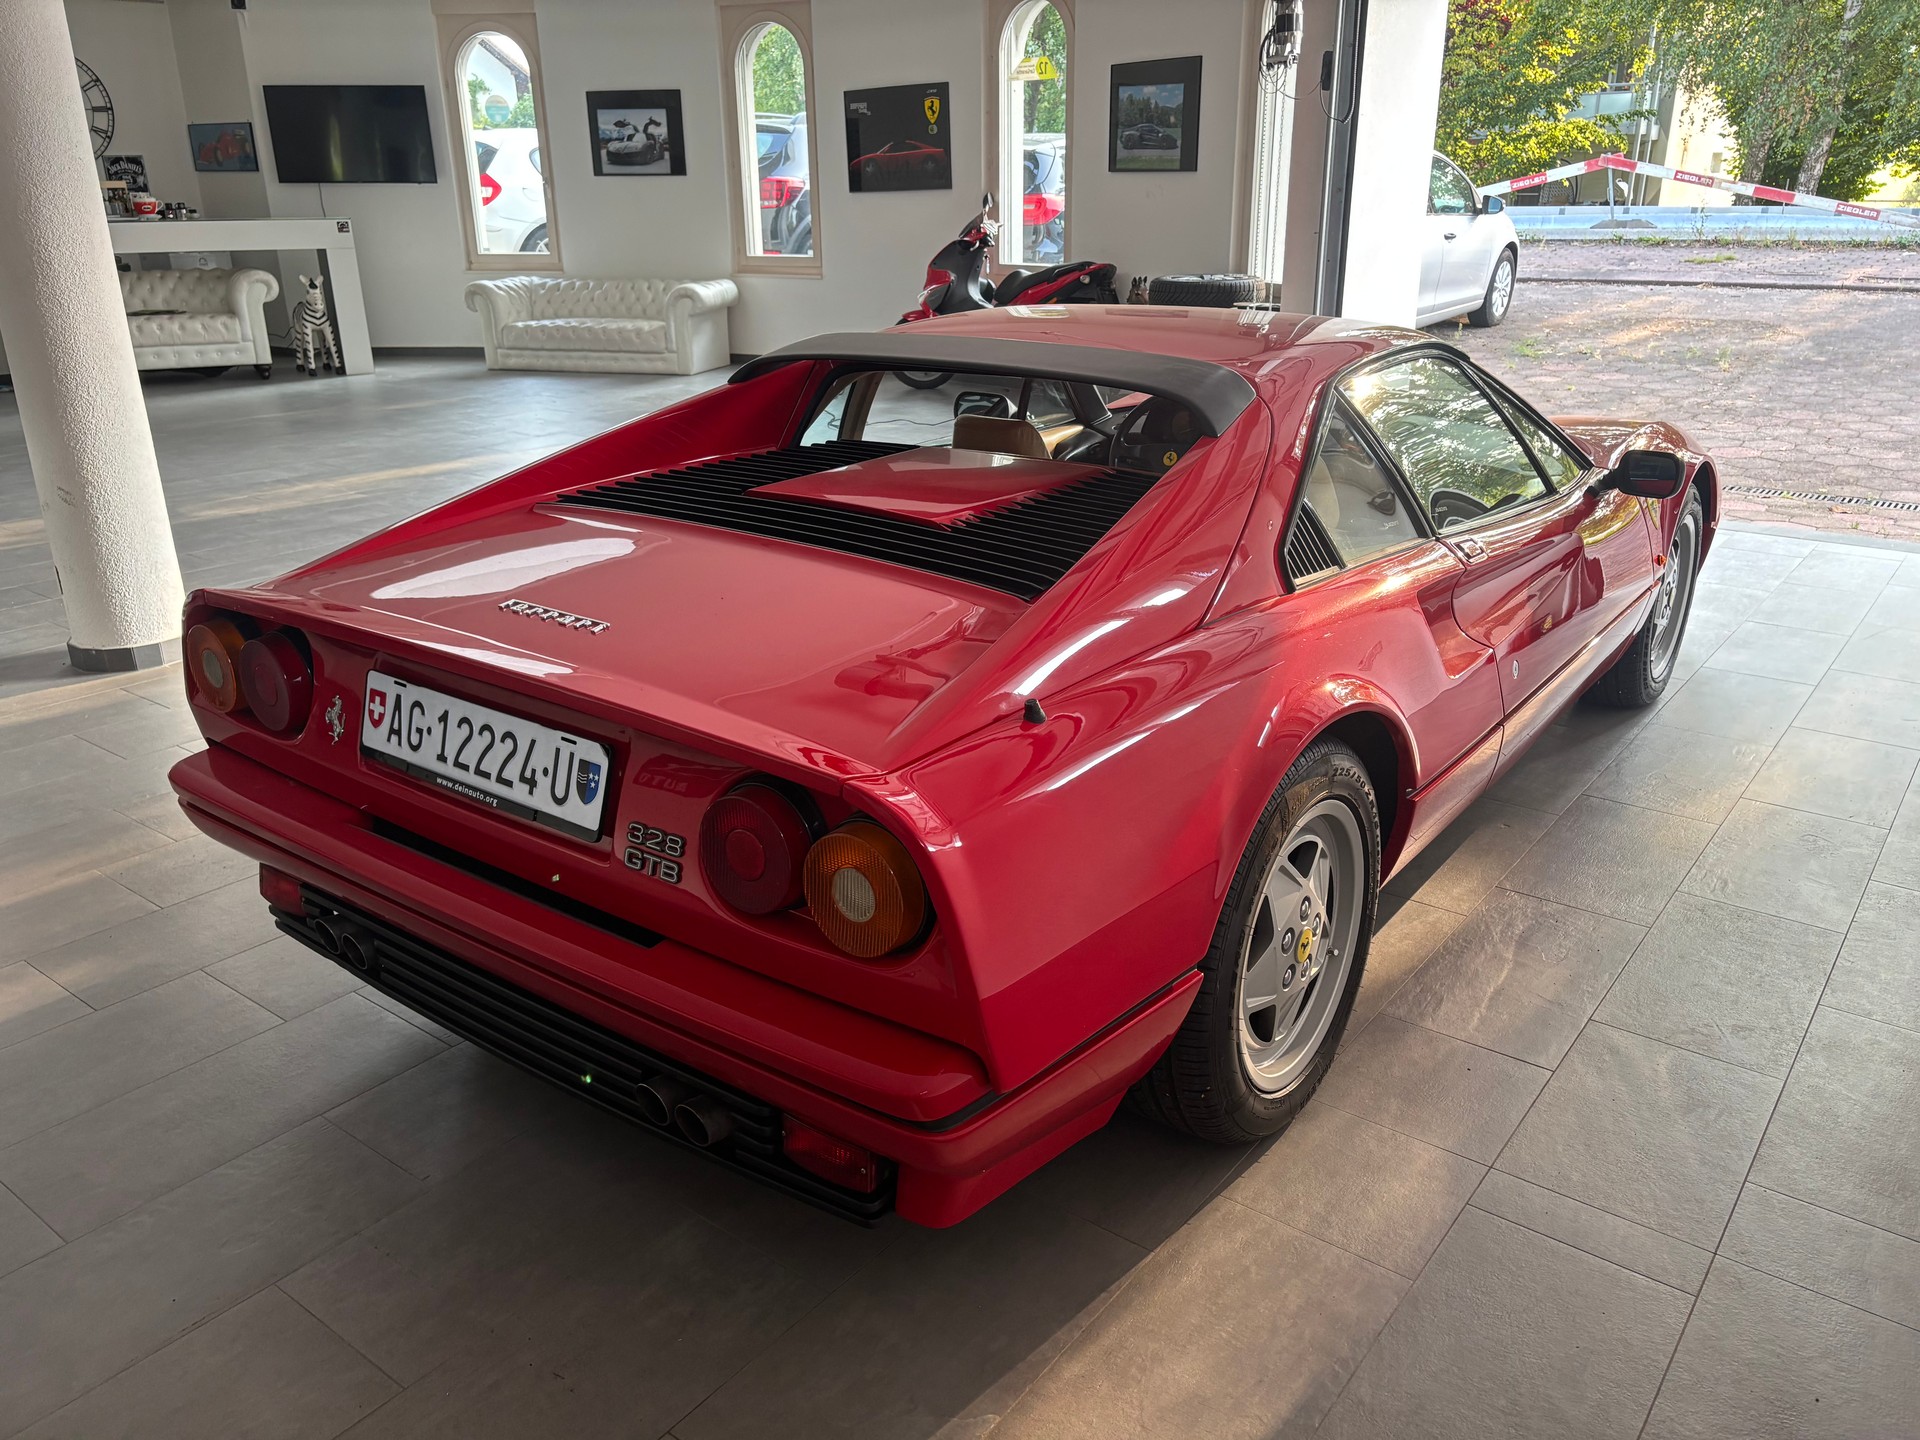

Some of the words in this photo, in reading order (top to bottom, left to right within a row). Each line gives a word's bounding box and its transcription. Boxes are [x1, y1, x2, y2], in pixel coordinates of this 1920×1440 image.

[1512, 175, 1546, 189] ZIEGLER
[1676, 172, 1712, 185] ZIEGLER
[1838, 204, 1878, 218] ZIEGLER
[436, 776, 498, 807] www.deinauto.org
[627, 822, 685, 857] 328
[624, 847, 682, 884] GTB
